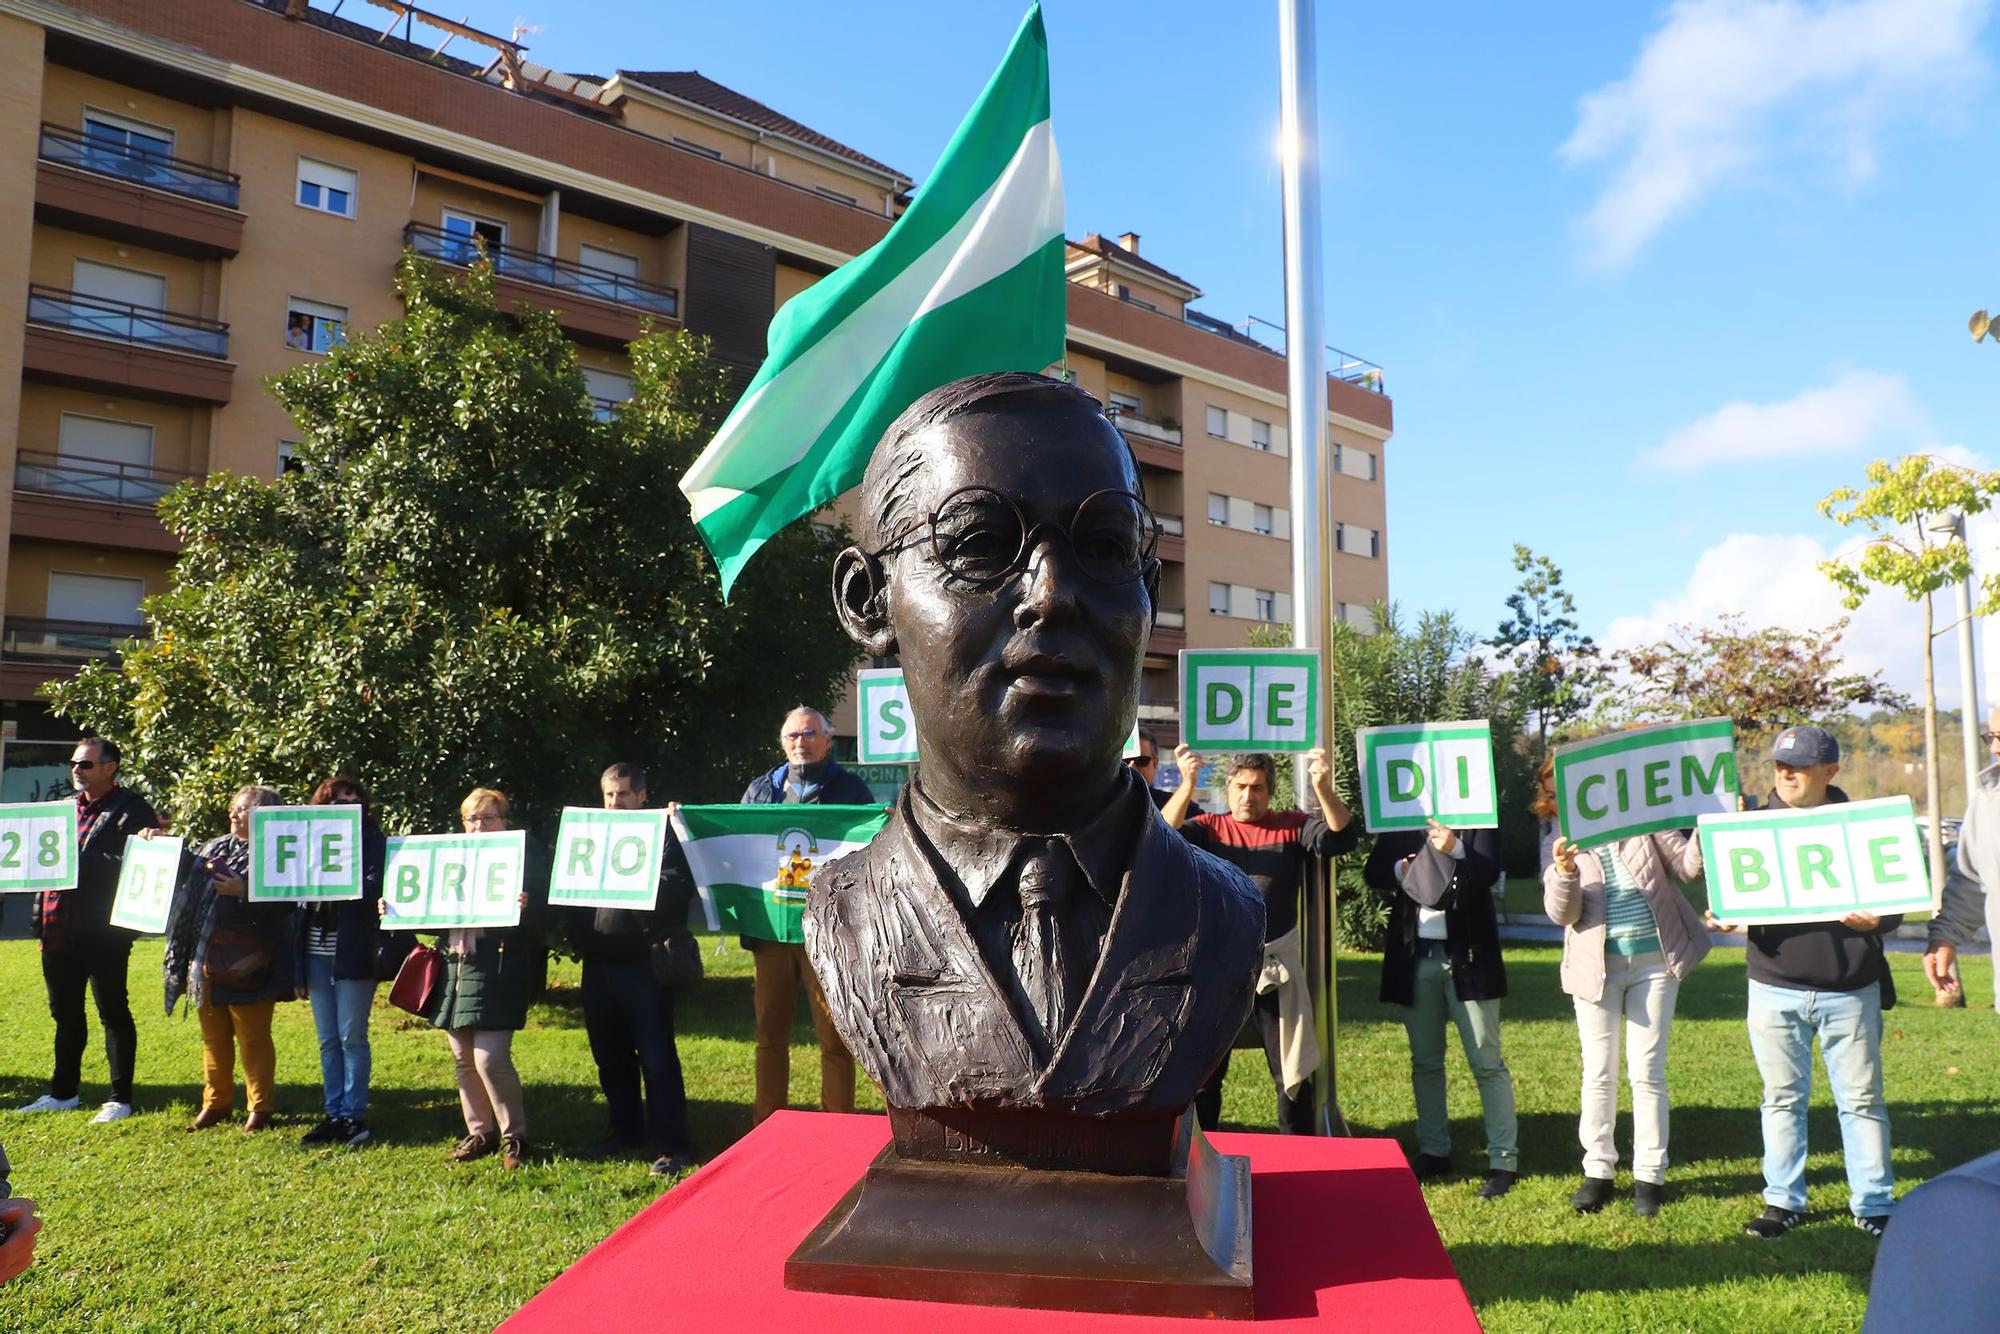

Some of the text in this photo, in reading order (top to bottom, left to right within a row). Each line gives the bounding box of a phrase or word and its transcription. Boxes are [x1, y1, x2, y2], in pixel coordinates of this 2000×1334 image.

[1205, 682, 1296, 727] DE
[1385, 755, 1470, 803] DI
[1575, 750, 1736, 821] CIEM
[1, 830, 61, 868] 28
[275, 833, 343, 874] FE
[566, 835, 647, 877] RO
[1728, 835, 1908, 893] BRE
[128, 863, 168, 905] DE
[397, 861, 509, 904] BRE
